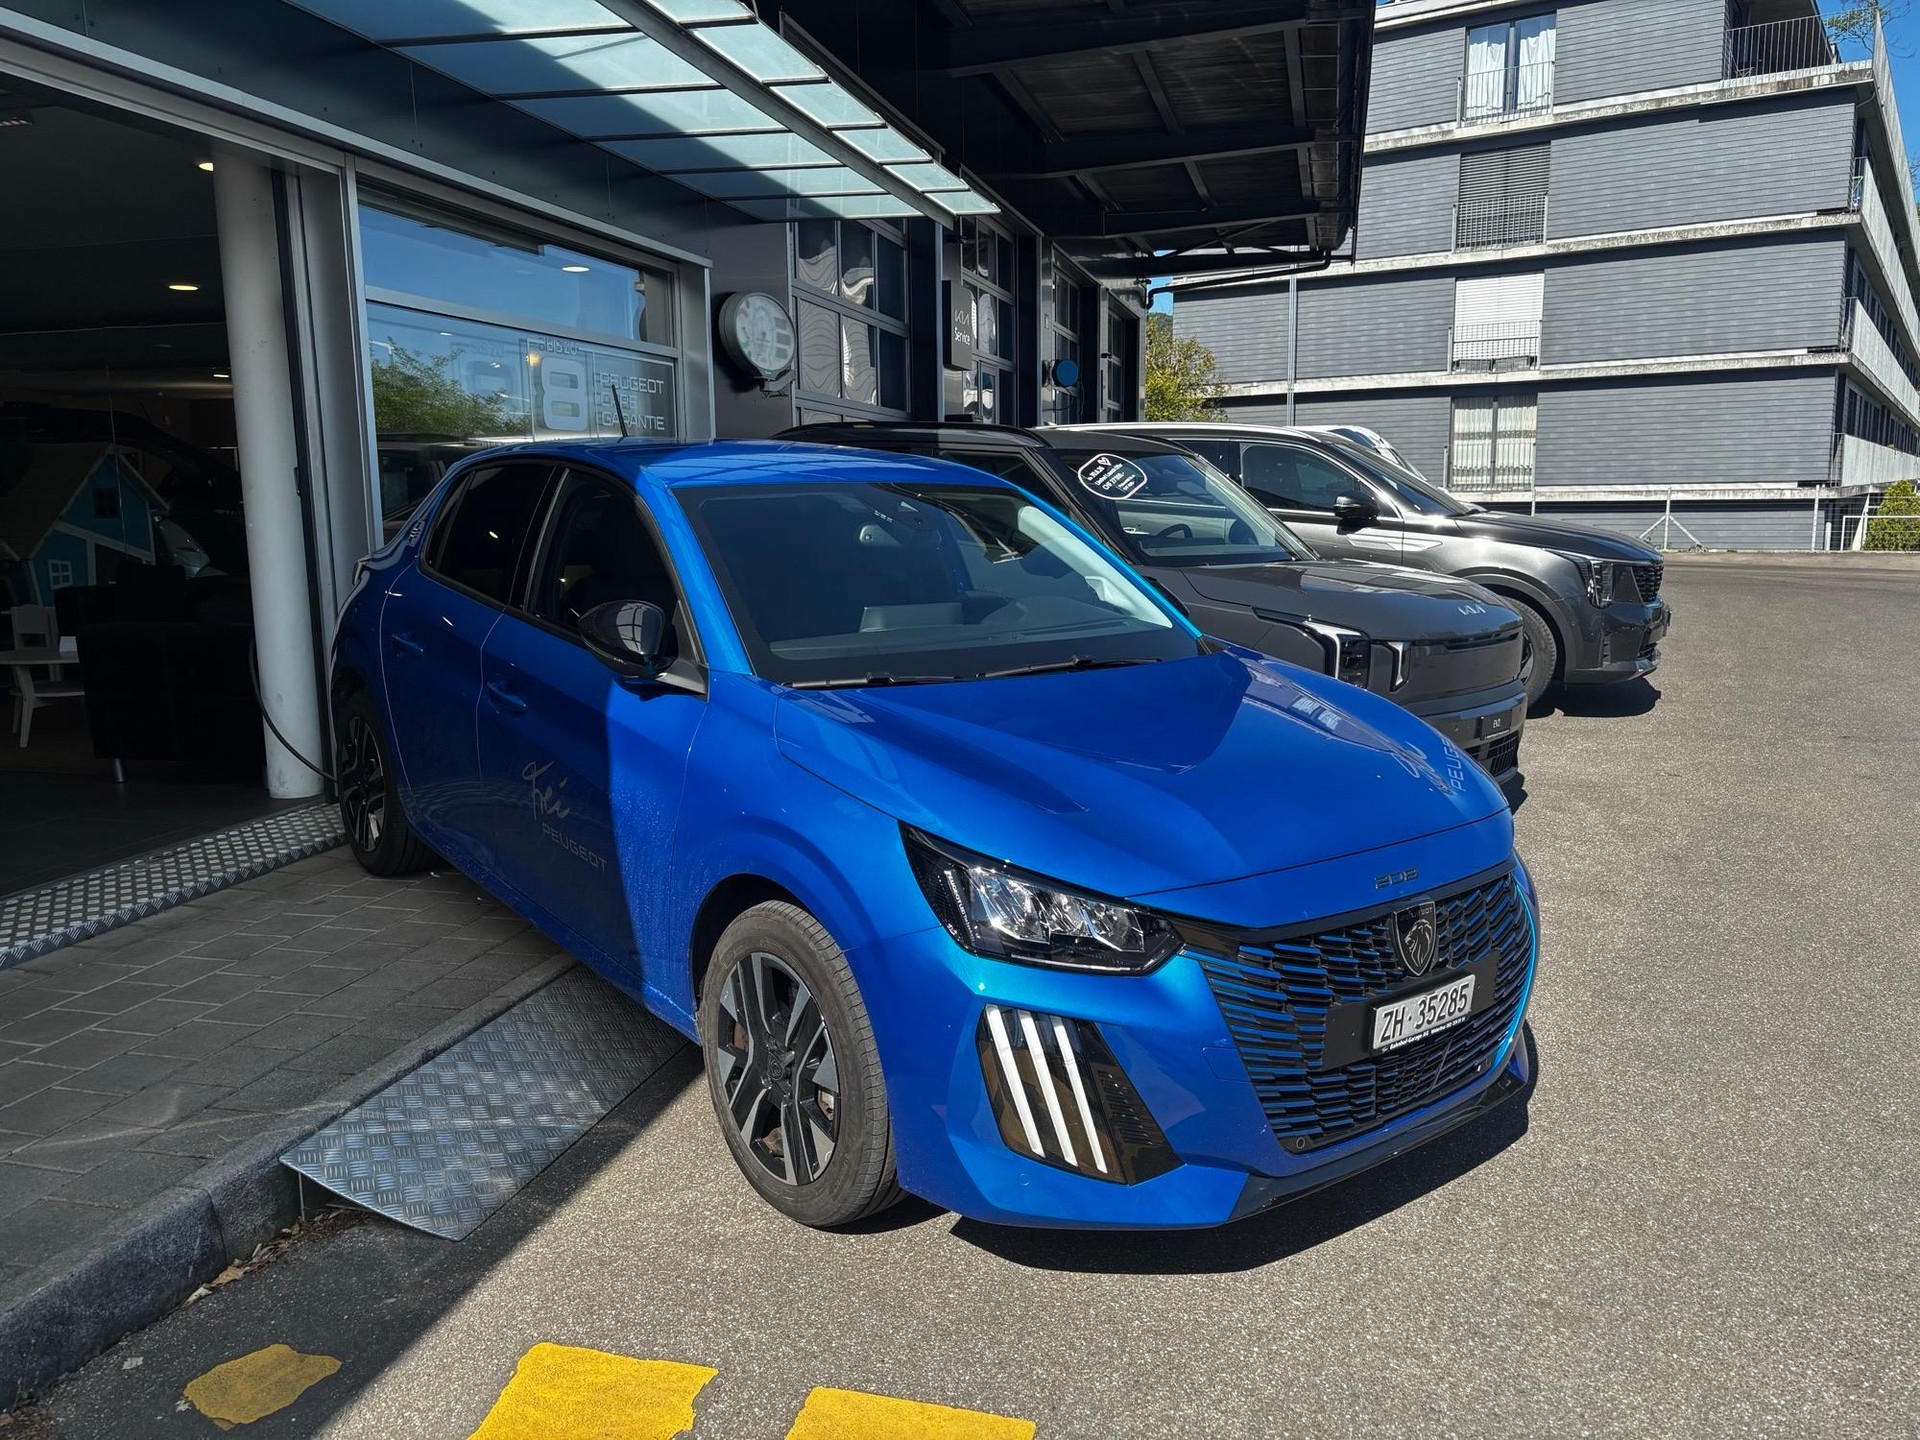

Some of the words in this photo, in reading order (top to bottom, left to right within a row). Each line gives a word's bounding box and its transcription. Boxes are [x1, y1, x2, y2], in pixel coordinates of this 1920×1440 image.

[954, 326, 971, 346] Service
[601, 372, 665, 394] PEUGEOT
[602, 411, 665, 430] GARANTIE
[542, 821, 608, 872] PEUGEOT
[1380, 1005, 1406, 1043] ZH
[1415, 983, 1469, 1029] 35285
